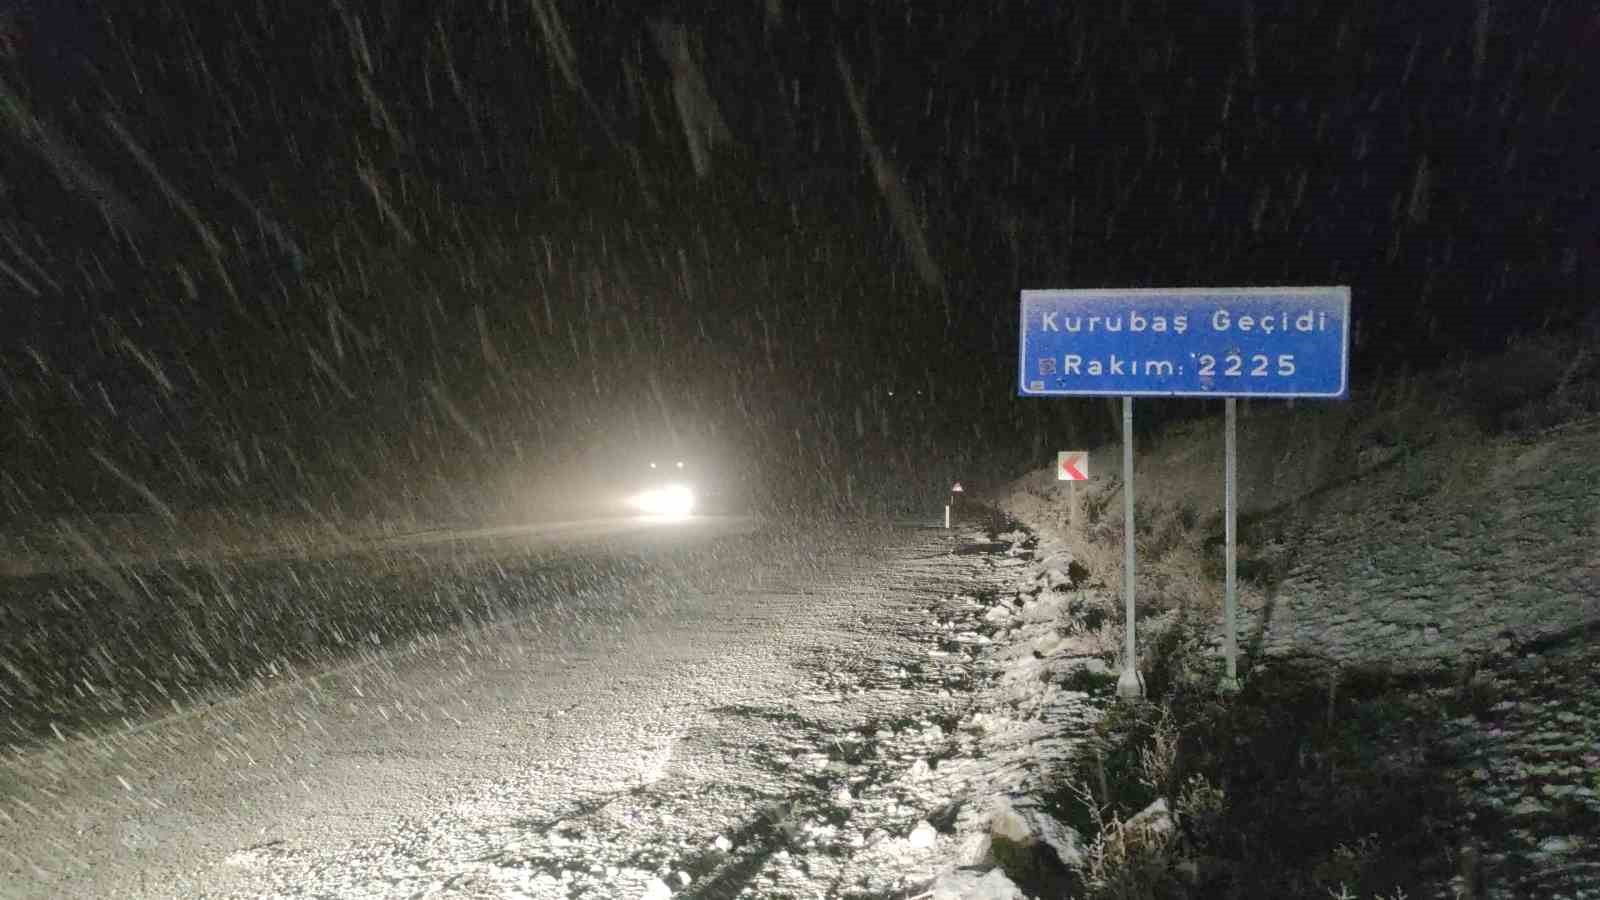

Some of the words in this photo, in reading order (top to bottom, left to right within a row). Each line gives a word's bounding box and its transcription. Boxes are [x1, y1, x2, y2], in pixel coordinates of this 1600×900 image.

[1042, 311, 1189, 335] Kurubaş
[1212, 310, 1327, 335] Geçidi
[1064, 354, 1184, 376] Rakım:
[1198, 354, 1296, 376] 2225
